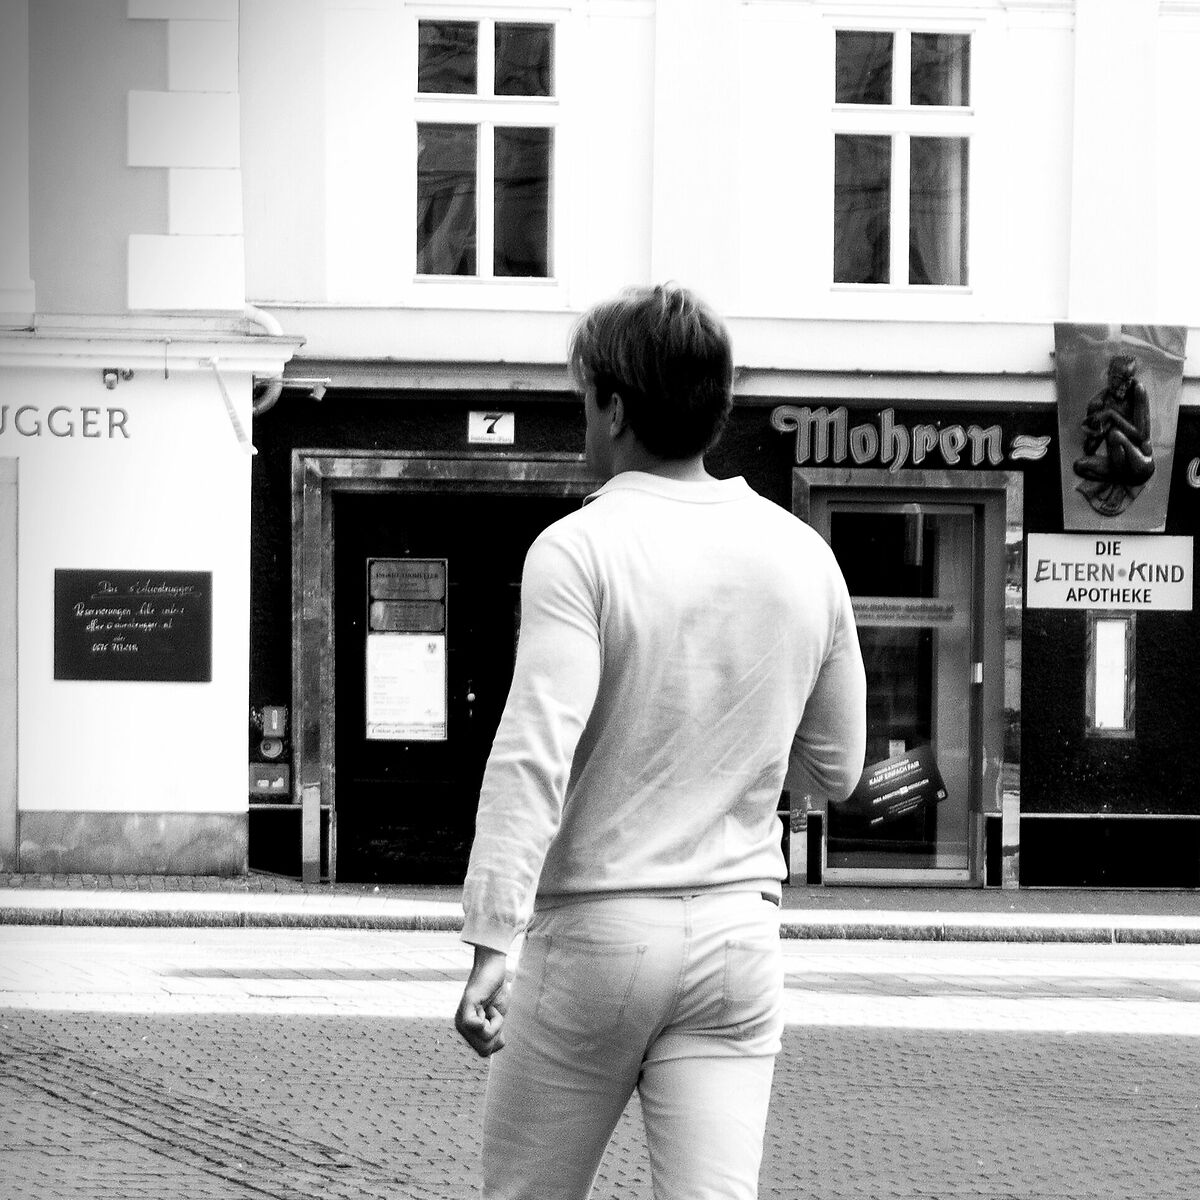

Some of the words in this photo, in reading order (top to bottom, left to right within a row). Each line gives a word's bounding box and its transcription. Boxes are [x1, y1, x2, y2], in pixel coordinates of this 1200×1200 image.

[483, 413, 504, 434] 7
[1095, 541, 1121, 556] DIE
[1066, 587, 1152, 603] APOTHEKE
